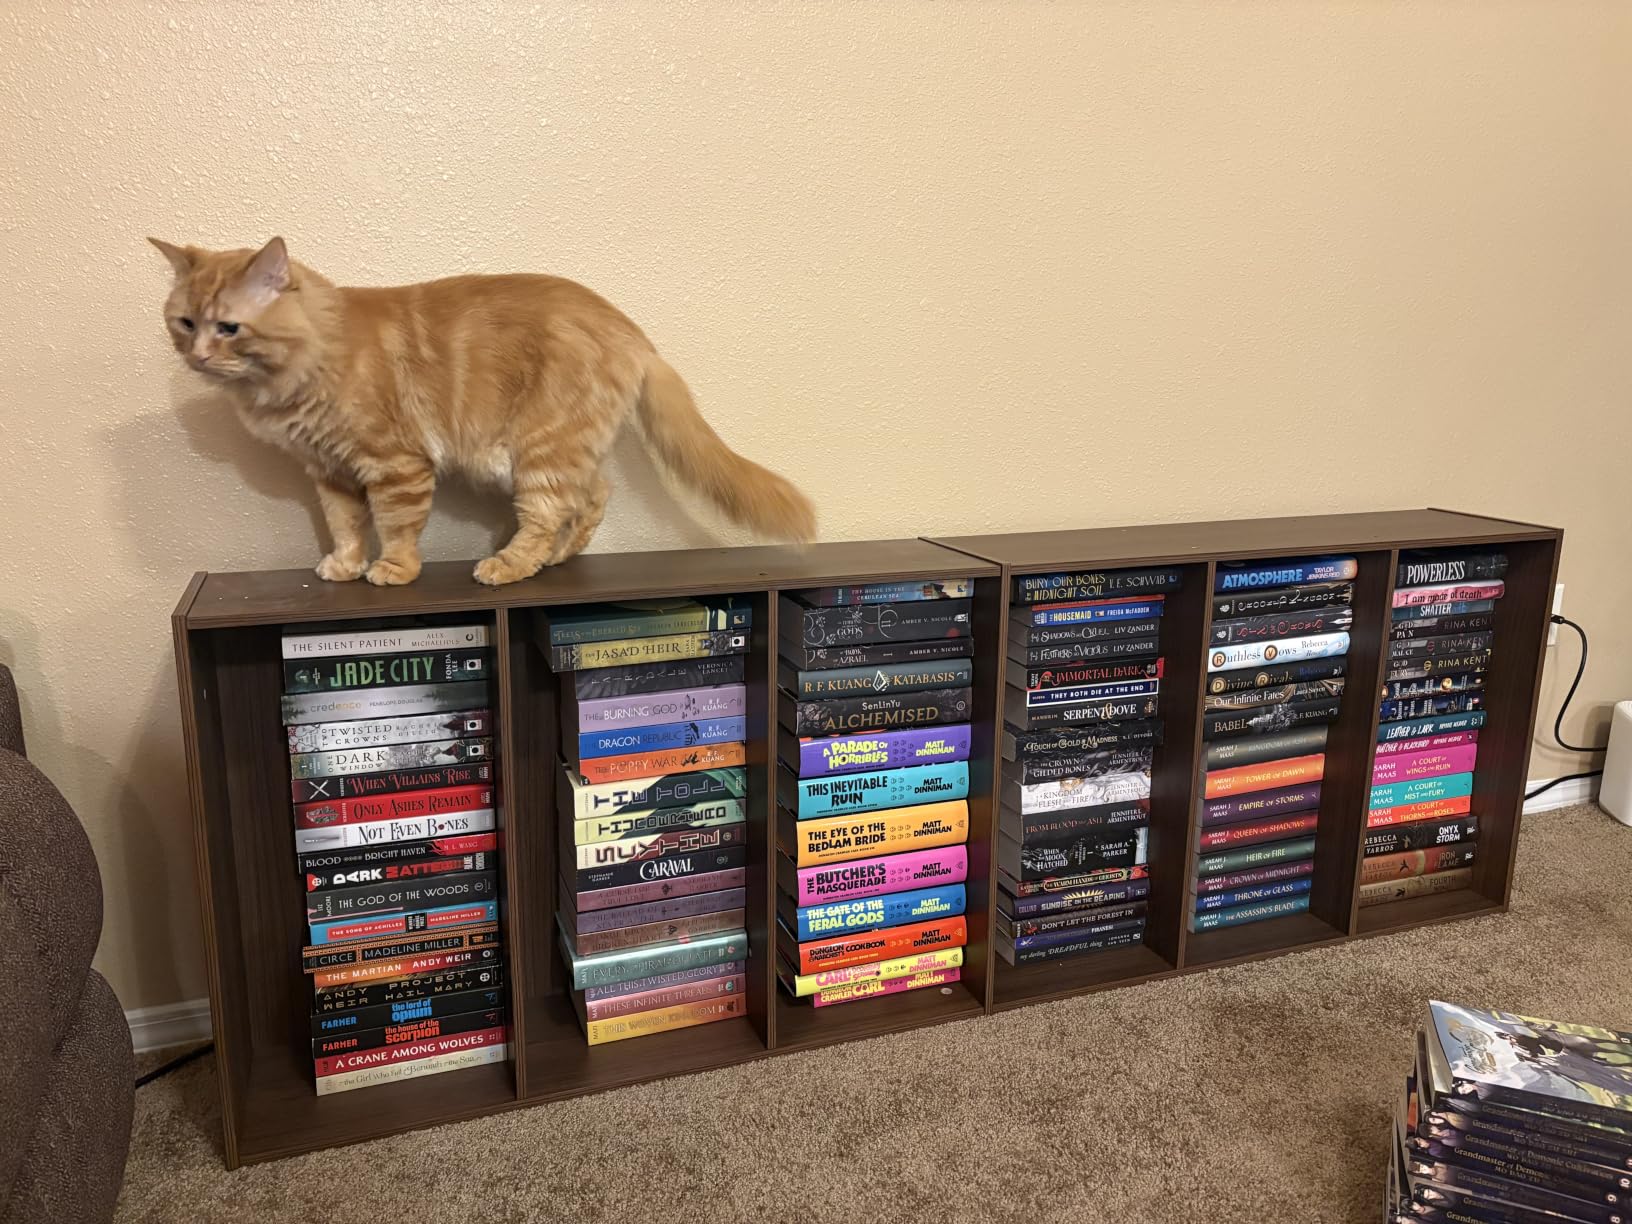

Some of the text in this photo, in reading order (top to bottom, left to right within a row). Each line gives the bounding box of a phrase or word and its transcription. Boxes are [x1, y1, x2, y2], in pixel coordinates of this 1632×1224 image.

[1222, 569, 1303, 589] ATMOSPHERE
[1406, 561, 1466, 584] POWERLESS
[1025, 574, 1105, 590] BURY OUR BONES
[1080, 585, 1104, 597] SOIL
[1460, 590, 1482, 599] death
[1053, 610, 1092, 622] HOUSEMAID
[1420, 603, 1452, 617] SHATTER
[1114, 624, 1155, 634] LIV ZANDER
[292, 641, 353, 652] THE SILENT
[595, 642, 682, 661] JASAD HEIR
[1126, 642, 1154, 651] ZANDER
[1212, 645, 1297, 668] Ruthless Vows
[1438, 655, 1488, 668] RINA KENT
[330, 660, 385, 687] JADE
[390, 657, 434, 682] CITY
[893, 671, 955, 686] KATABASIS
[805, 677, 872, 693] R. F. KUANG
[1211, 671, 1293, 694] Divine Rivals
[1051, 692, 1067, 700] THEY
[1131, 684, 1144, 692] END
[1214, 690, 1284, 707] Our Infinite Fates
[603, 704, 677, 721] BURNING GOD
[862, 699, 900, 711] SenLinYu
[1063, 704, 1137, 721] SERPENT DOVE
[823, 706, 939, 731] ALCHEMISED
[1305, 710, 1328, 718] KUANG
[328, 724, 392, 736] TWISTED
[1214, 719, 1248, 732] BABEL
[1386, 724, 1435, 739] LEATHER LARK
[335, 735, 387, 745] CROWNS
[702, 729, 727, 738] KUANG
[598, 736, 640, 749] DRAGON
[831, 740, 878, 754] PARADE
[336, 751, 388, 765] DARK
[915, 745, 955, 757] DINNIMAN
[610, 758, 677, 775] POPPY WAR
[701, 755, 725, 763] KUANG
[829, 751, 888, 770] HORRIBLES
[1418, 756, 1441, 765] COURT
[1244, 768, 1305, 783] TOWER DAWN
[1377, 772, 1396, 780] MAAS
[1406, 767, 1426, 775] WINGS
[348, 775, 386, 794] WHEN
[389, 770, 440, 786] VILLAINS
[806, 775, 888, 797] THIS INEVITABLE
[914, 783, 953, 794] DINNIMAN
[1415, 782, 1437, 790] COURT
[831, 792, 863, 807] RUIN
[1374, 797, 1393, 806] MAAS
[1404, 789, 1446, 800] MIST FURY
[354, 794, 471, 819] ONLY ASHES REMAIN
[1239, 794, 1304, 811] EMPIRE STORMS
[1374, 816, 1393, 825] MAAS
[390, 821, 421, 839] EVEN
[808, 822, 886, 842] THE EYE OF THE
[913, 825, 952, 837] DINNIMAN
[1233, 820, 1305, 839] QUEEN SHADOWS
[1439, 825, 1459, 835] ONYX
[808, 833, 886, 853] BEDLAM BRIDE
[1436, 834, 1460, 844] STORM
[1103, 848, 1128, 858] PARKER
[1366, 845, 1394, 854] YARROS
[1037, 859, 1068, 871] HATCHED
[1246, 853, 1262, 862] HEIR
[639, 858, 694, 881] CARAVAL
[816, 862, 887, 885] BUTCHER'S
[913, 867, 952, 880] DINNIMAN
[1229, 866, 1300, 885] CROWN MIDNIGHT
[807, 877, 815, 894] THE
[816, 876, 887, 895] MASQUERADE
[1234, 884, 1294, 901] THRONE GLASS
[339, 884, 469, 909] THE GOD OF THE WOODS
[807, 899, 884, 920] THE GATE OF THE
[912, 903, 950, 916] DINNIMAN
[1236, 902, 1295, 919] ASSASSIN'S BLADE
[809, 912, 885, 933] FERAL GODS
[1041, 921, 1065, 930] DON'T
[1081, 916, 1096, 924] THE
[1097, 912, 1124, 921] FOREST
[364, 937, 460, 958] MADELINE MILLER
[913, 934, 951, 948] DINNIMAN
[319, 953, 353, 965] CIRCE
[412, 953, 472, 969] ANDY WEIR
[909, 960, 947, 973] DINNIMAN
[326, 964, 401, 982] THE MARTIAN
[596, 965, 718, 996] ALL GLORY
[388, 972, 467, 990] PROJECT
[906, 974, 945, 988] DINNIMAN
[385, 981, 473, 1001] HAIL MARY
[392, 1006, 432, 1022] opium
[321, 1016, 357, 1030] FARMER
[385, 1026, 440, 1044] scorpion
[323, 1039, 357, 1051] FARMER
[336, 1035, 484, 1068] A CRANE AMONG WOLVES
[1454, 1147, 1506, 1167] Grandmaster
[1619, 1178, 1631, 1188] 10
[1607, 1194, 1617, 1203] 9
